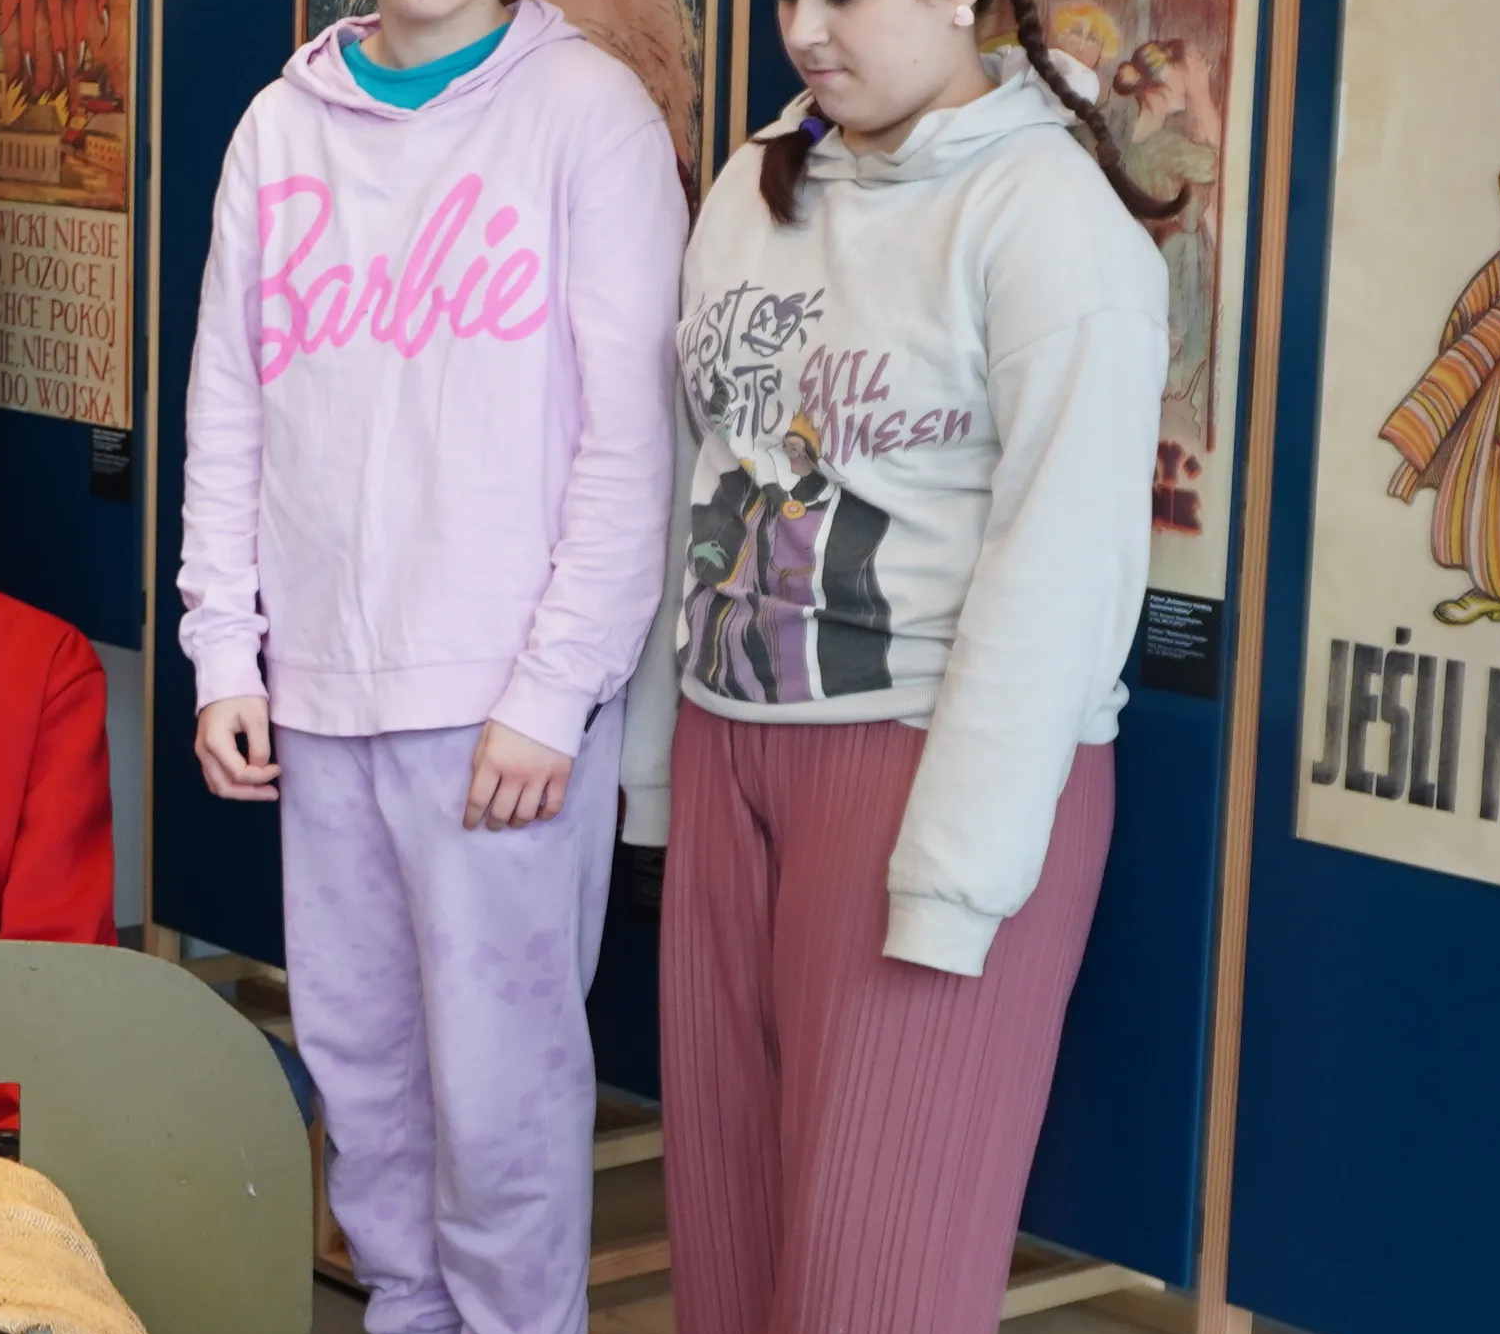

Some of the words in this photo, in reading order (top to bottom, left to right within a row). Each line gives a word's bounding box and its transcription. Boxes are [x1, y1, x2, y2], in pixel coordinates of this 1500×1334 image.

[53, 214, 119, 260] NIESIE
[257, 172, 550, 387] Barbie
[49, 298, 117, 347] POKÓJ
[22, 334, 79, 376] NIECH
[1, 373, 28, 407] DO
[799, 344, 891, 416] EVIL
[1310, 626, 1466, 813] JEŚLI
